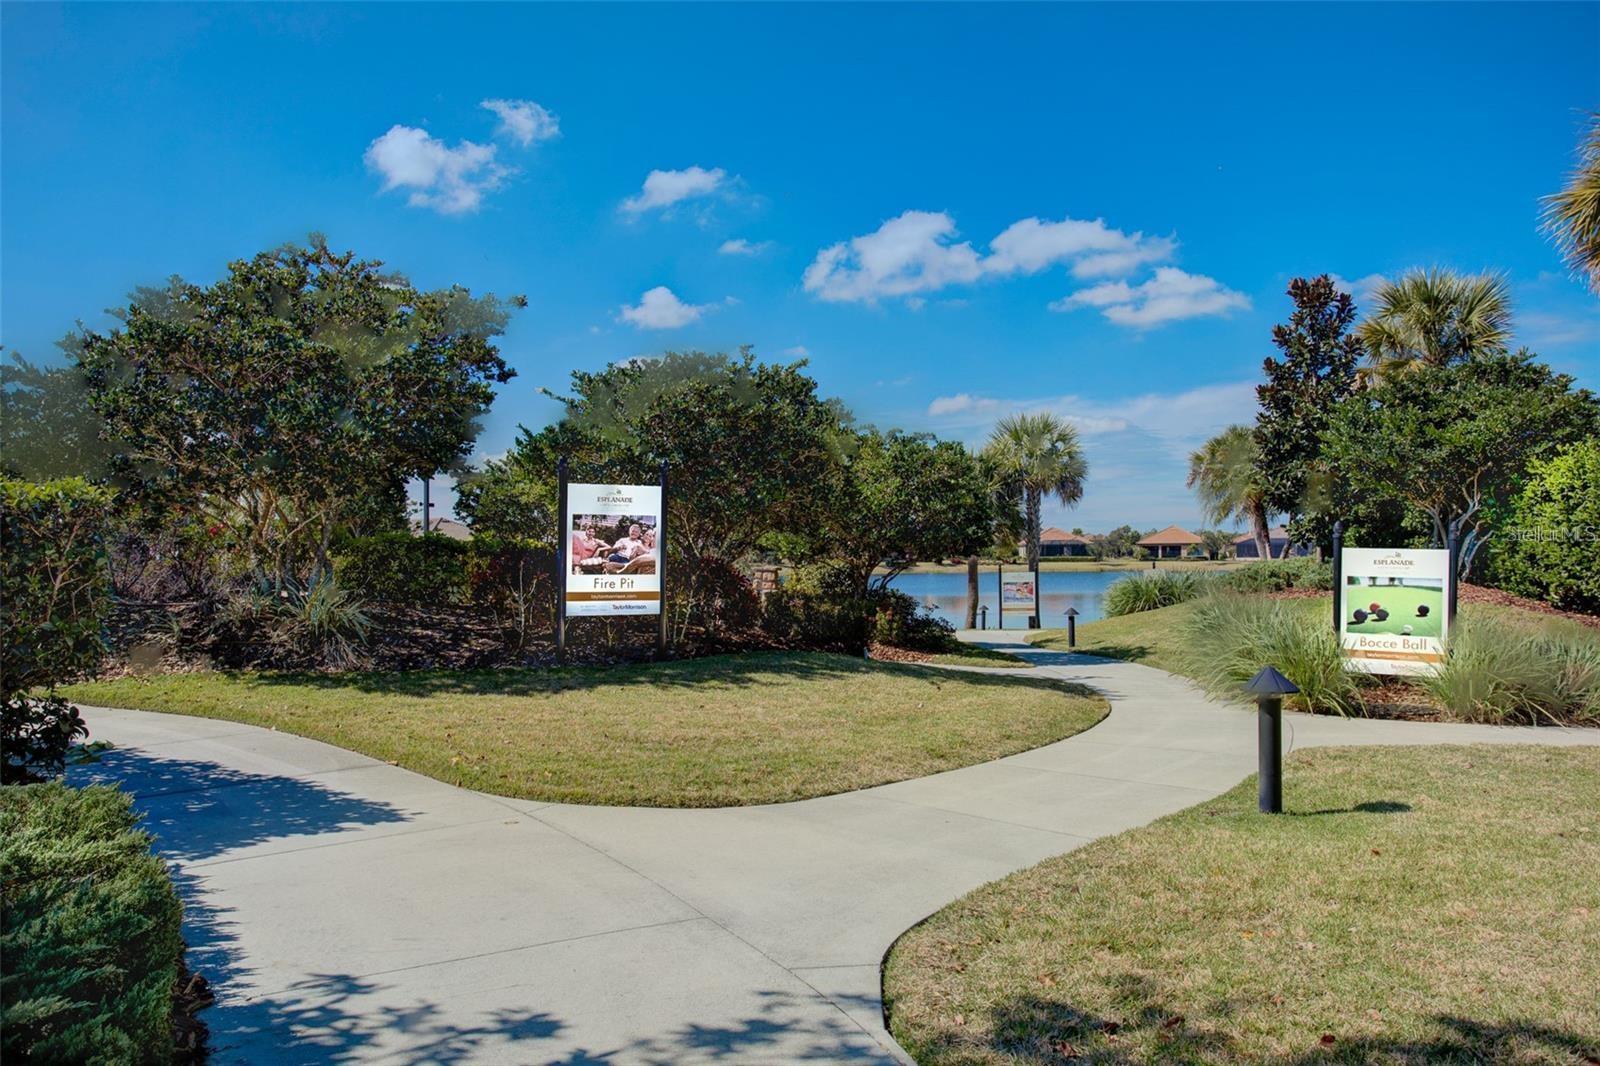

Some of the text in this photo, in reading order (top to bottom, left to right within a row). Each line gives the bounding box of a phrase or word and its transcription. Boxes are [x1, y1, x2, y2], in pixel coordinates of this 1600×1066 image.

[593, 578, 635, 589] Fire Pit
[1360, 637, 1427, 650] Bocce Ball
